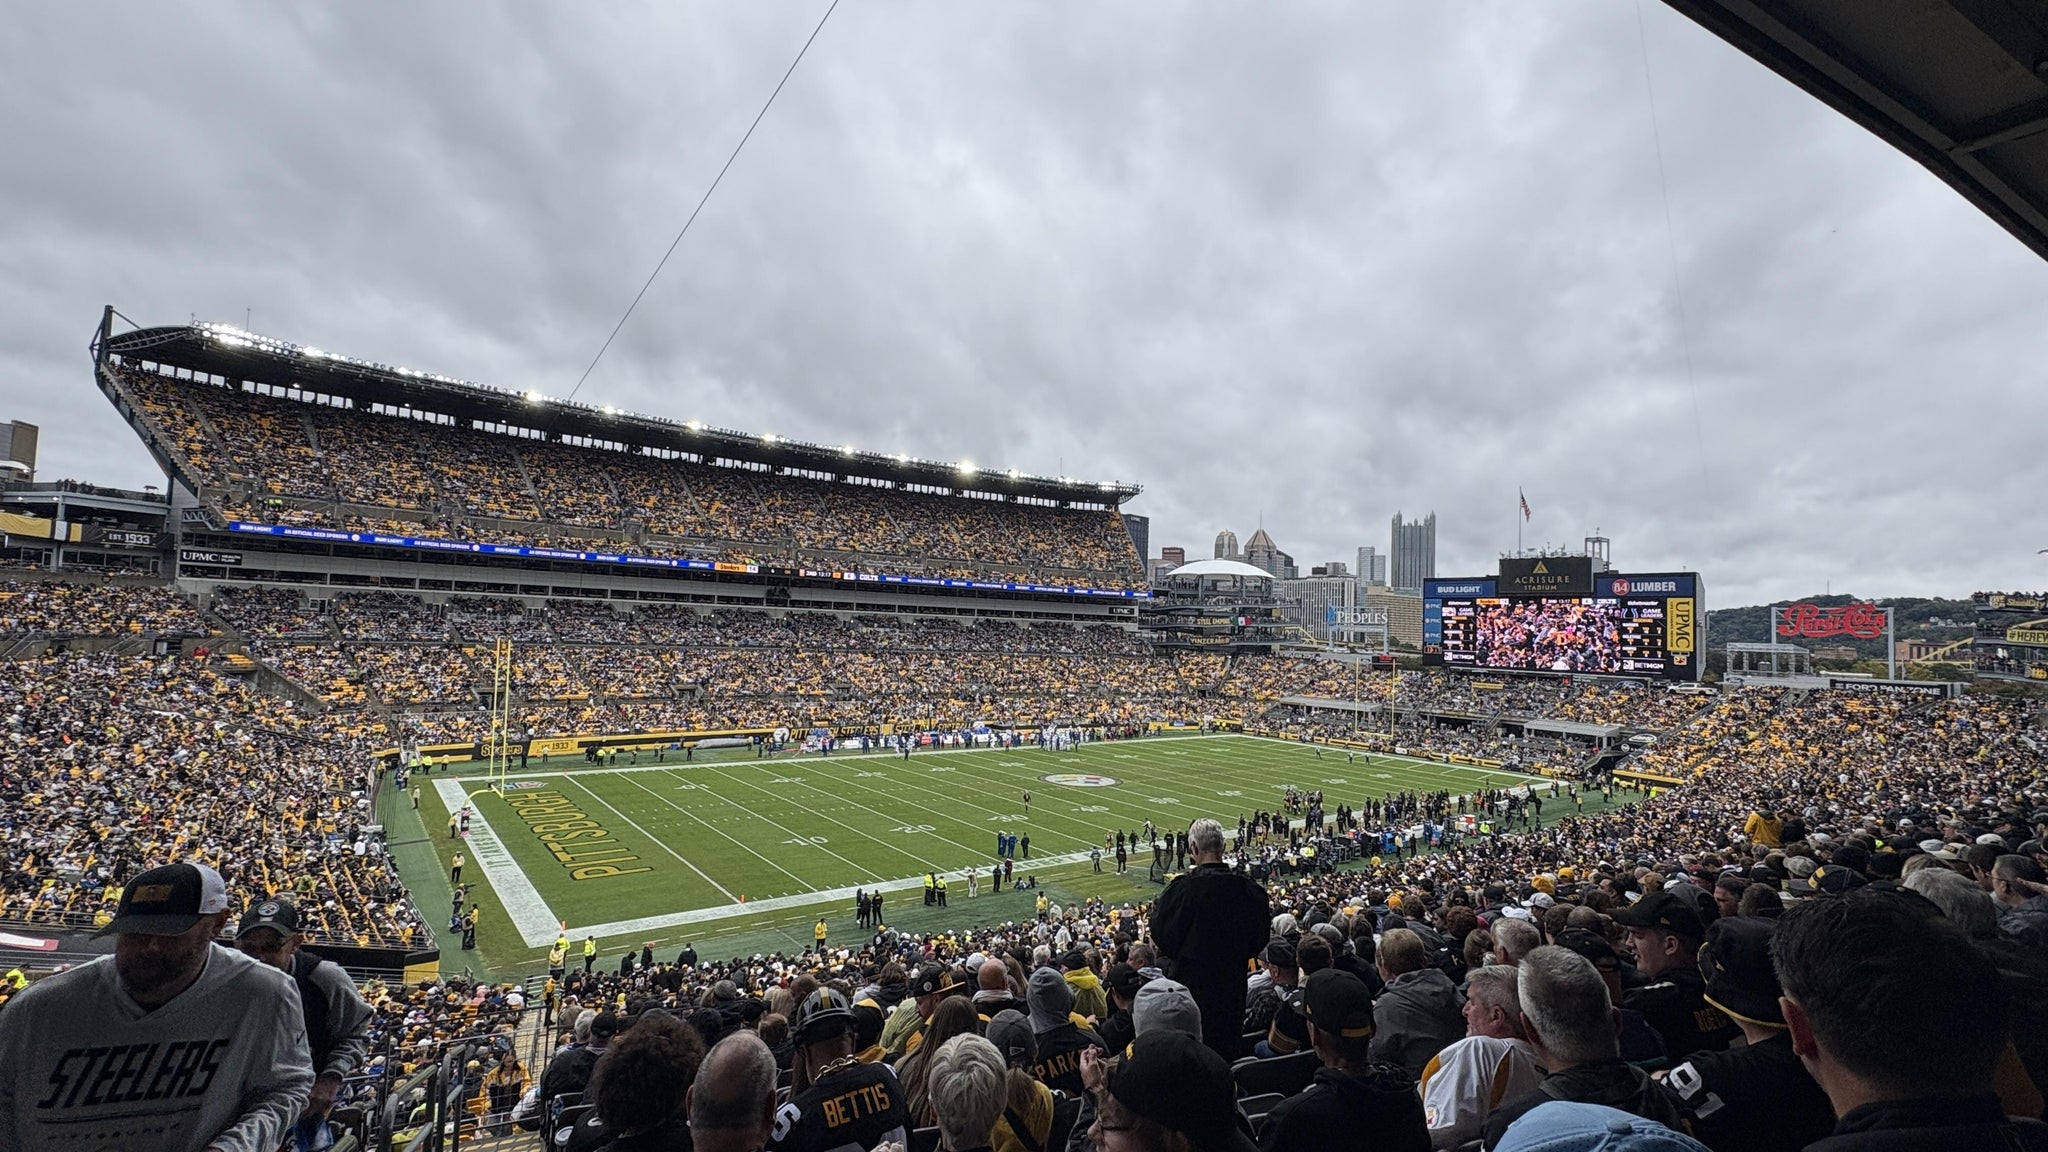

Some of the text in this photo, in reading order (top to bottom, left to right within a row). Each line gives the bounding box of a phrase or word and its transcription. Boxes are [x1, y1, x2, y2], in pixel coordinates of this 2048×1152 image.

[125, 533, 150, 544] 1933
[182, 552, 218, 562] UPMC
[1515, 575, 1570, 584] ACRISURE
[1437, 584, 1480, 594] BUD LIGHT
[1613, 581, 1676, 594] 84 LUMBER
[1336, 611, 1388, 624] PEOPLES
[1675, 600, 1691, 648] UPMC
[1845, 683, 1877, 692] FORD
[552, 742, 569, 750] 1933
[503, 790, 655, 881] PITTSBURGH
[1034, 1049, 1083, 1082] PARK
[36, 1038, 231, 1110] STEELERS
[821, 1082, 891, 1129] BETTIS
